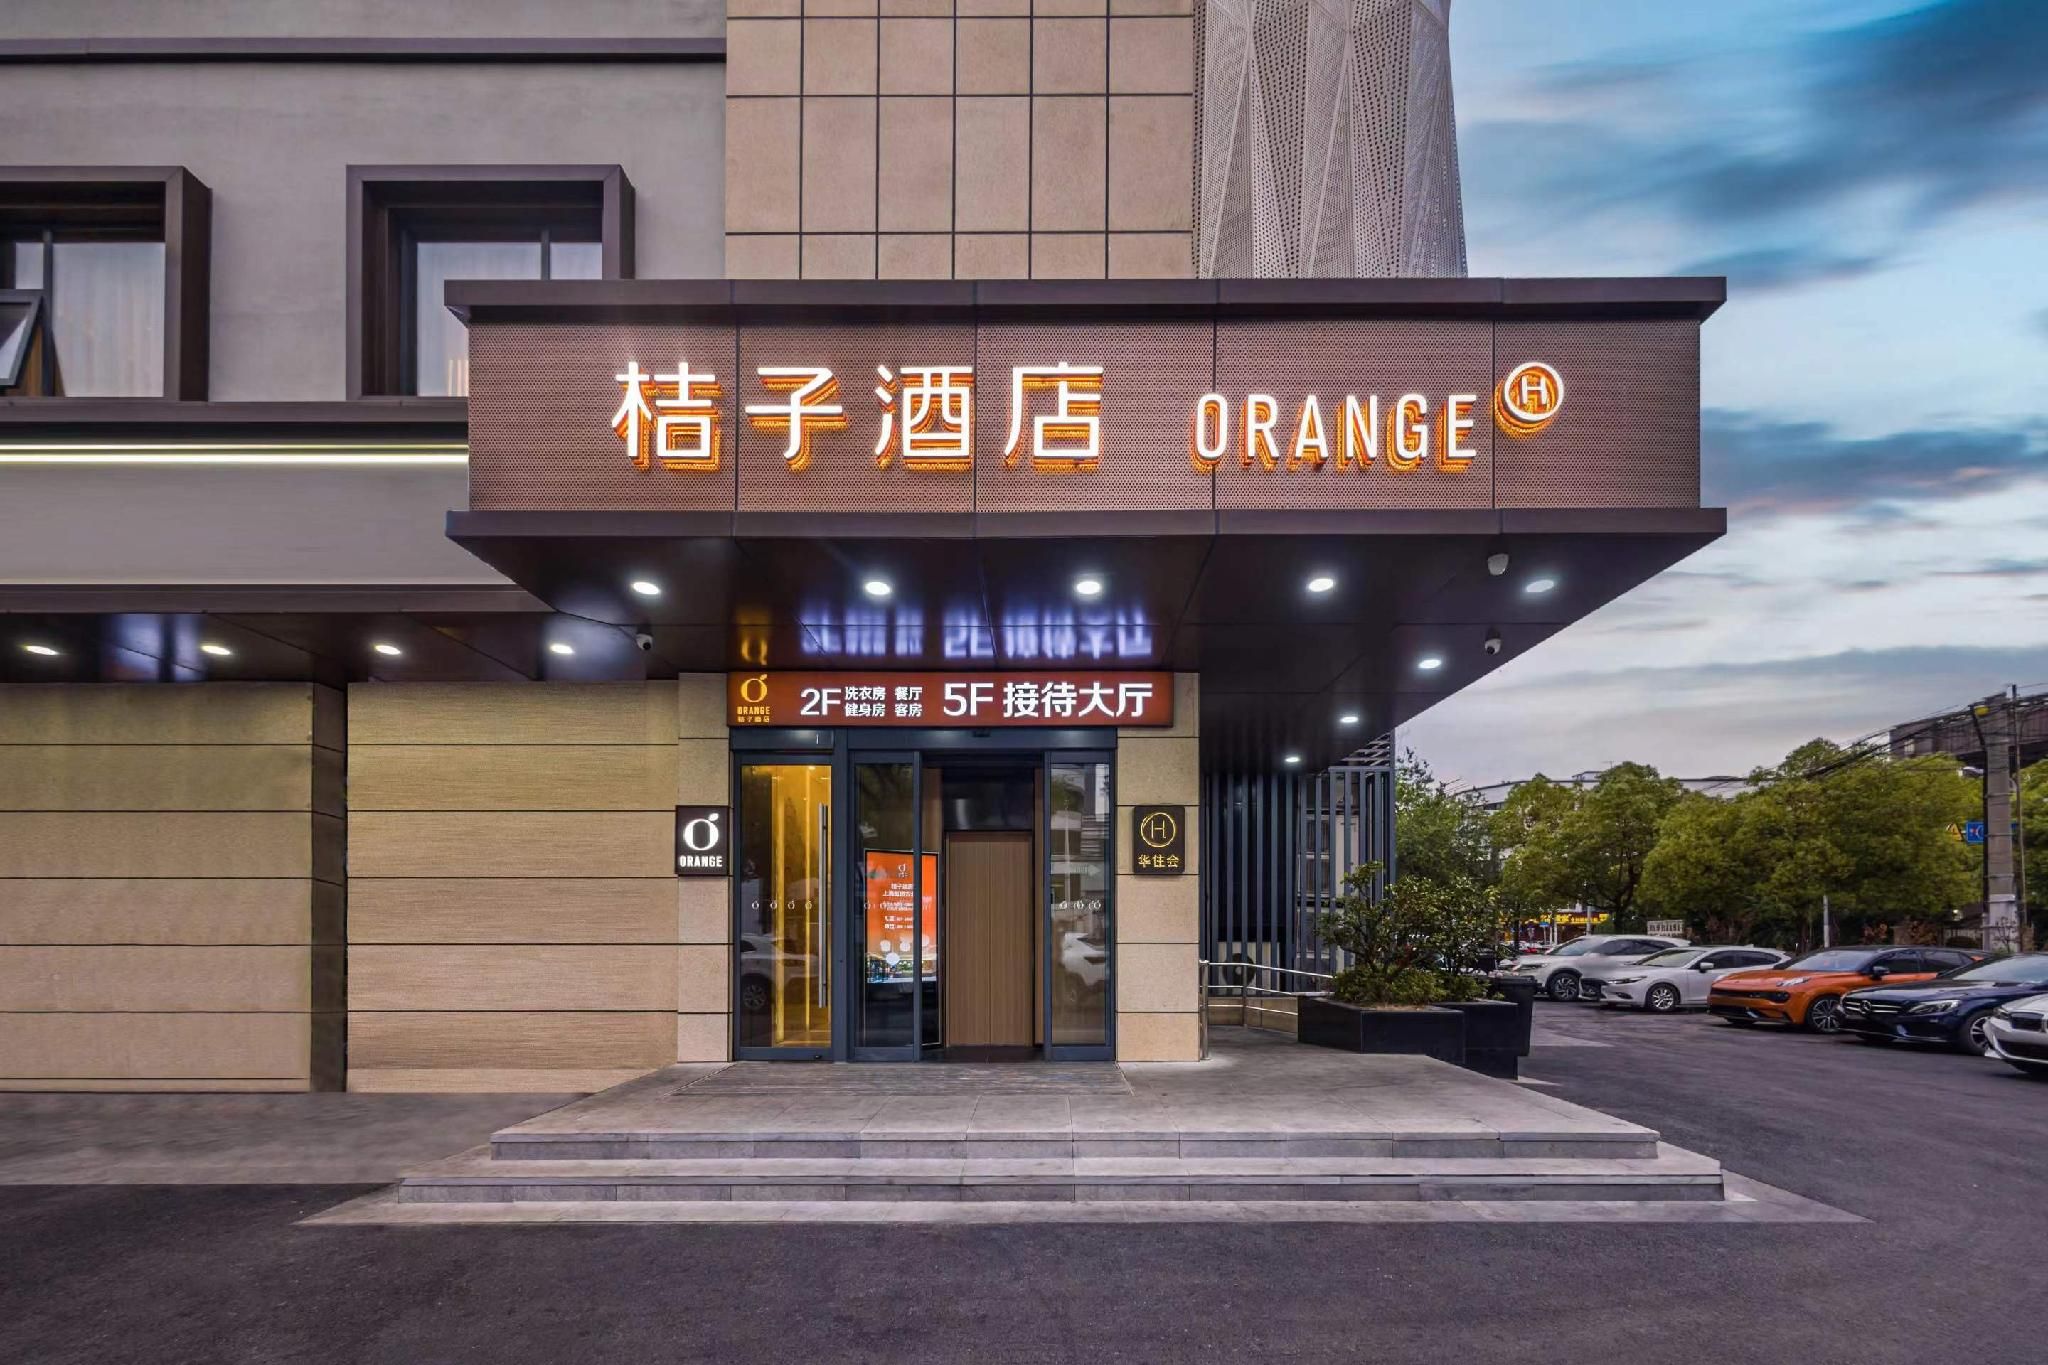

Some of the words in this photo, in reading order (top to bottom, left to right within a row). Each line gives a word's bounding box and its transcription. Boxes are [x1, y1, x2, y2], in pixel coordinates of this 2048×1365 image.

[612, 361, 1104, 458] 桔子酒店
[1196, 394, 1477, 458] ORANGE
[800, 688, 842, 716] 2F
[844, 686, 886, 701] 洗衣房
[894, 686, 923, 701] 餐厅
[943, 682, 994, 717] 5F
[1002, 682, 1153, 718] 接待大厅
[844, 702, 886, 717] 健身房
[894, 702, 923, 717] 客房
[679, 855, 723, 868] ORANGE
[1138, 854, 1180, 868] 华住会
